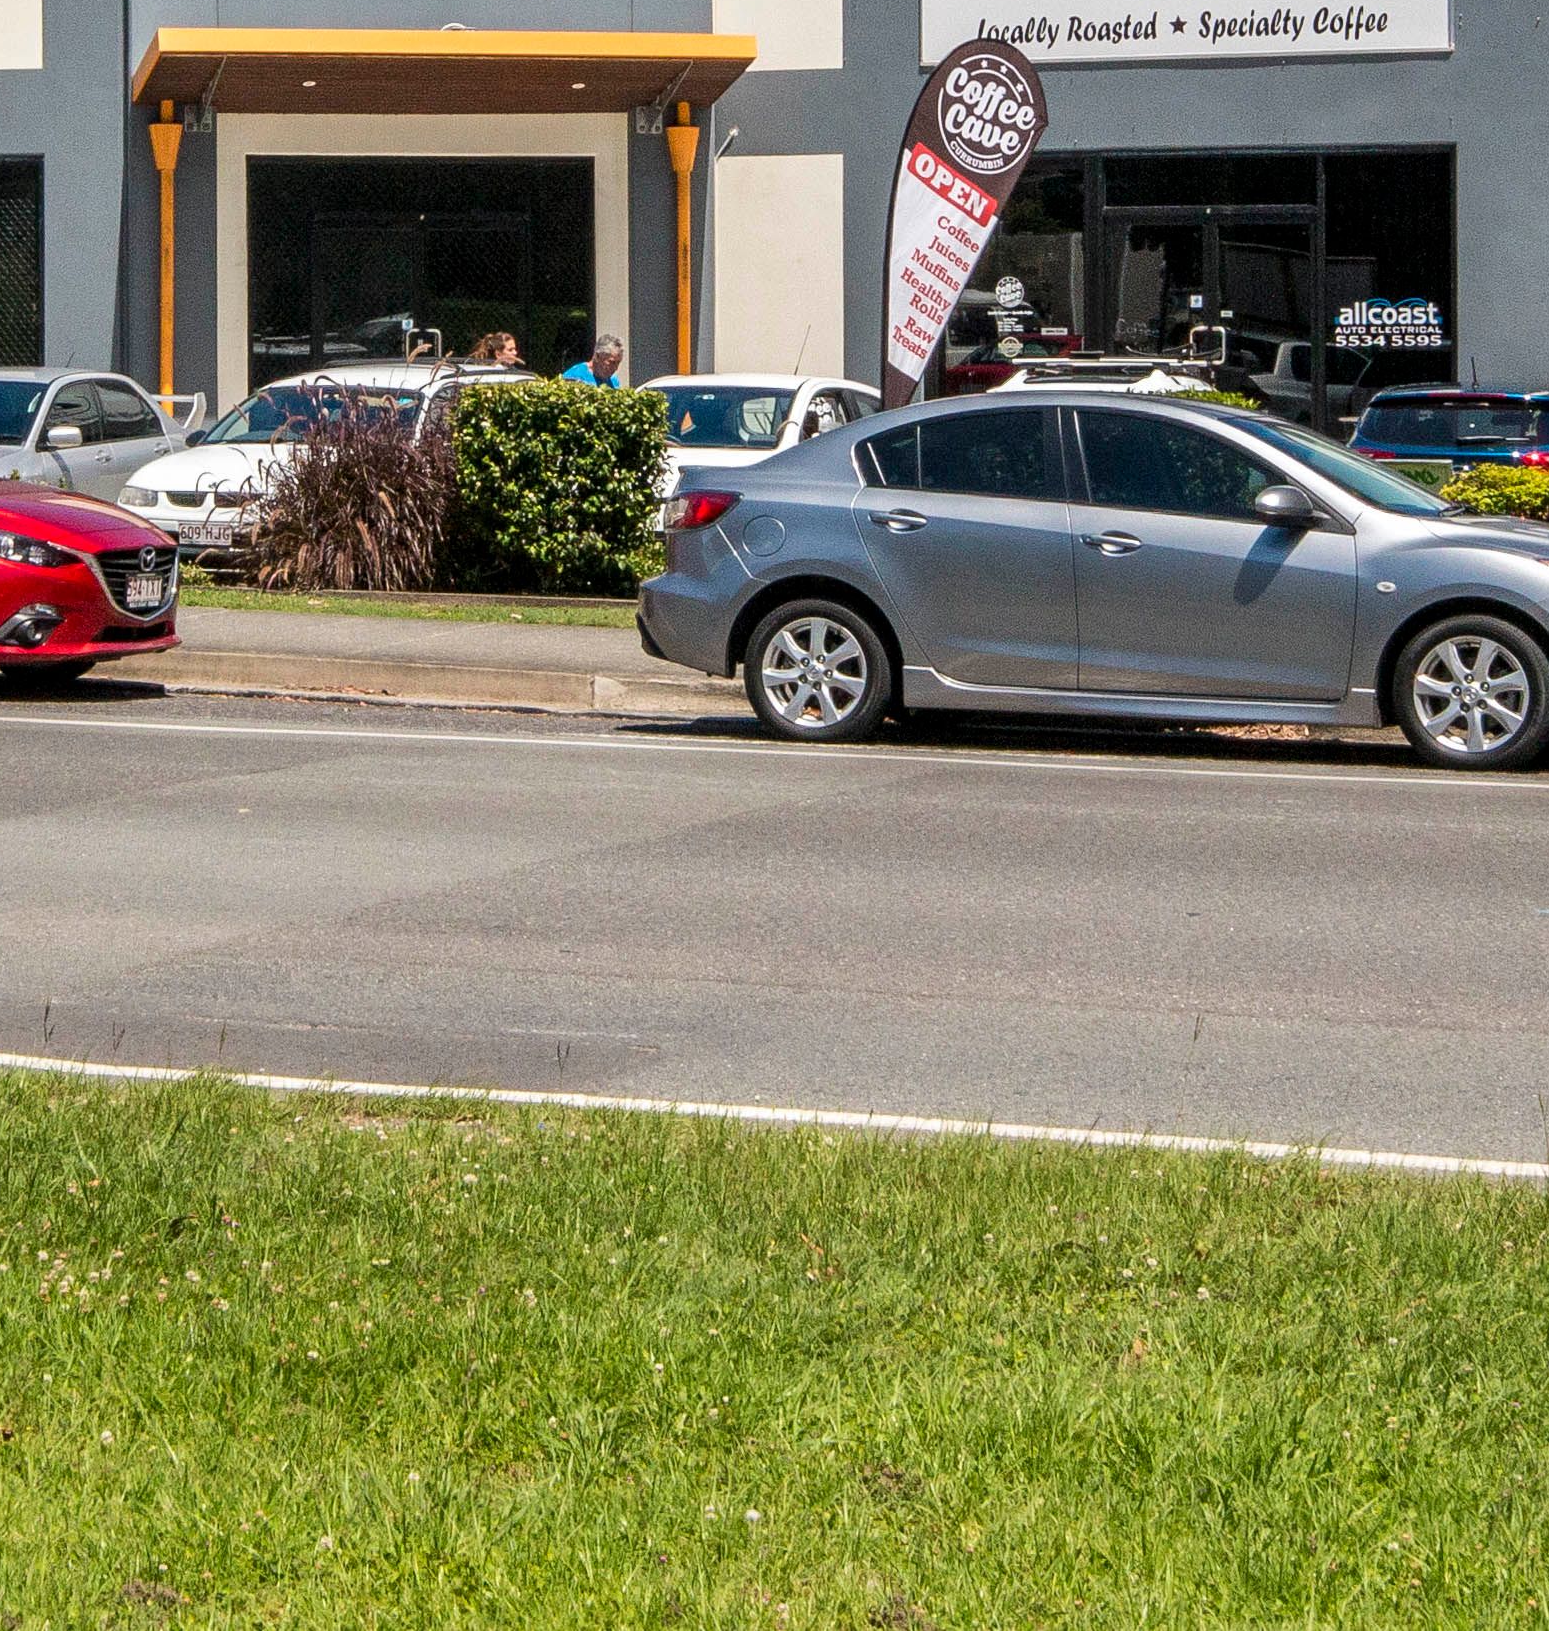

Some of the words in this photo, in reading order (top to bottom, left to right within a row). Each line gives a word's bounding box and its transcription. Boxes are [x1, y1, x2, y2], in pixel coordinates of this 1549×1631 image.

[977, 17, 1060, 51] Locally
[1067, 11, 1158, 44] Roasted
[1198, 7, 1305, 41] Specialty
[1312, 5, 1388, 36] Coffee
[946, 67, 1036, 130] Coffee
[945, 103, 1021, 155] Cave
[950, 140, 1004, 170] CURRUMBIN
[914, 153, 989, 219] OPEN
[937, 215, 980, 253] Coffee
[911, 247, 961, 292] Muffins
[928, 235, 971, 273] Juices
[900, 266, 952, 312] Healthy
[909, 293, 944, 325] Rolls
[1339, 301, 1439, 325] allcoast
[893, 325, 928, 359] Treats
[904, 315, 935, 344] Raw
[1335, 326, 1366, 334] AUTO
[1371, 326, 1442, 334] ELECTRICAL
[1335, 335, 1386, 347] 5534
[1391, 335, 1442, 347] 5595
